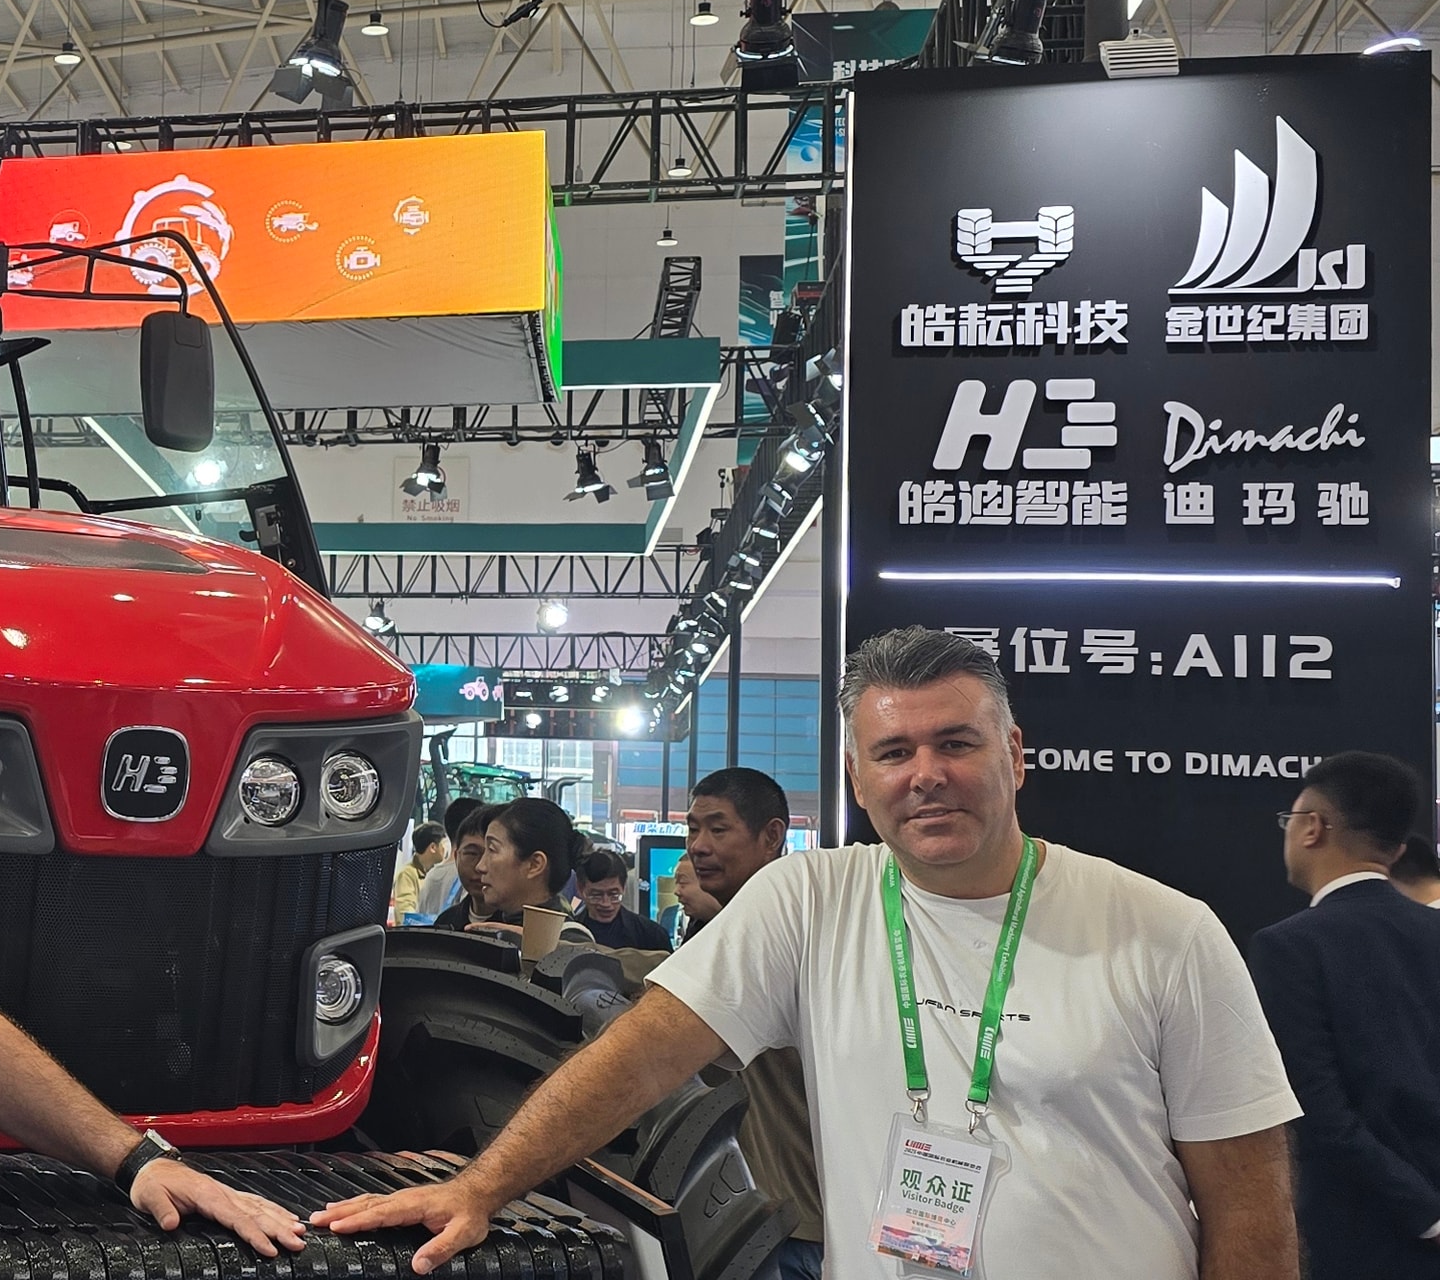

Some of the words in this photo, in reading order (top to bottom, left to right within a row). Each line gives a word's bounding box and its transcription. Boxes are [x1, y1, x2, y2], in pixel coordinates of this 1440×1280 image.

[1164, 303, 1370, 344] 金世纪集团
[1163, 401, 1366, 474] Dimachi
[401, 498, 460, 513] 禁止吸烟
[1125, 750, 1172, 773] TO
[1184, 752, 1329, 779] DIMACH
[900, 1168, 974, 1203] 观众证
[902, 1189, 933, 1205] Visitor
[934, 1198, 965, 1214] Badge
